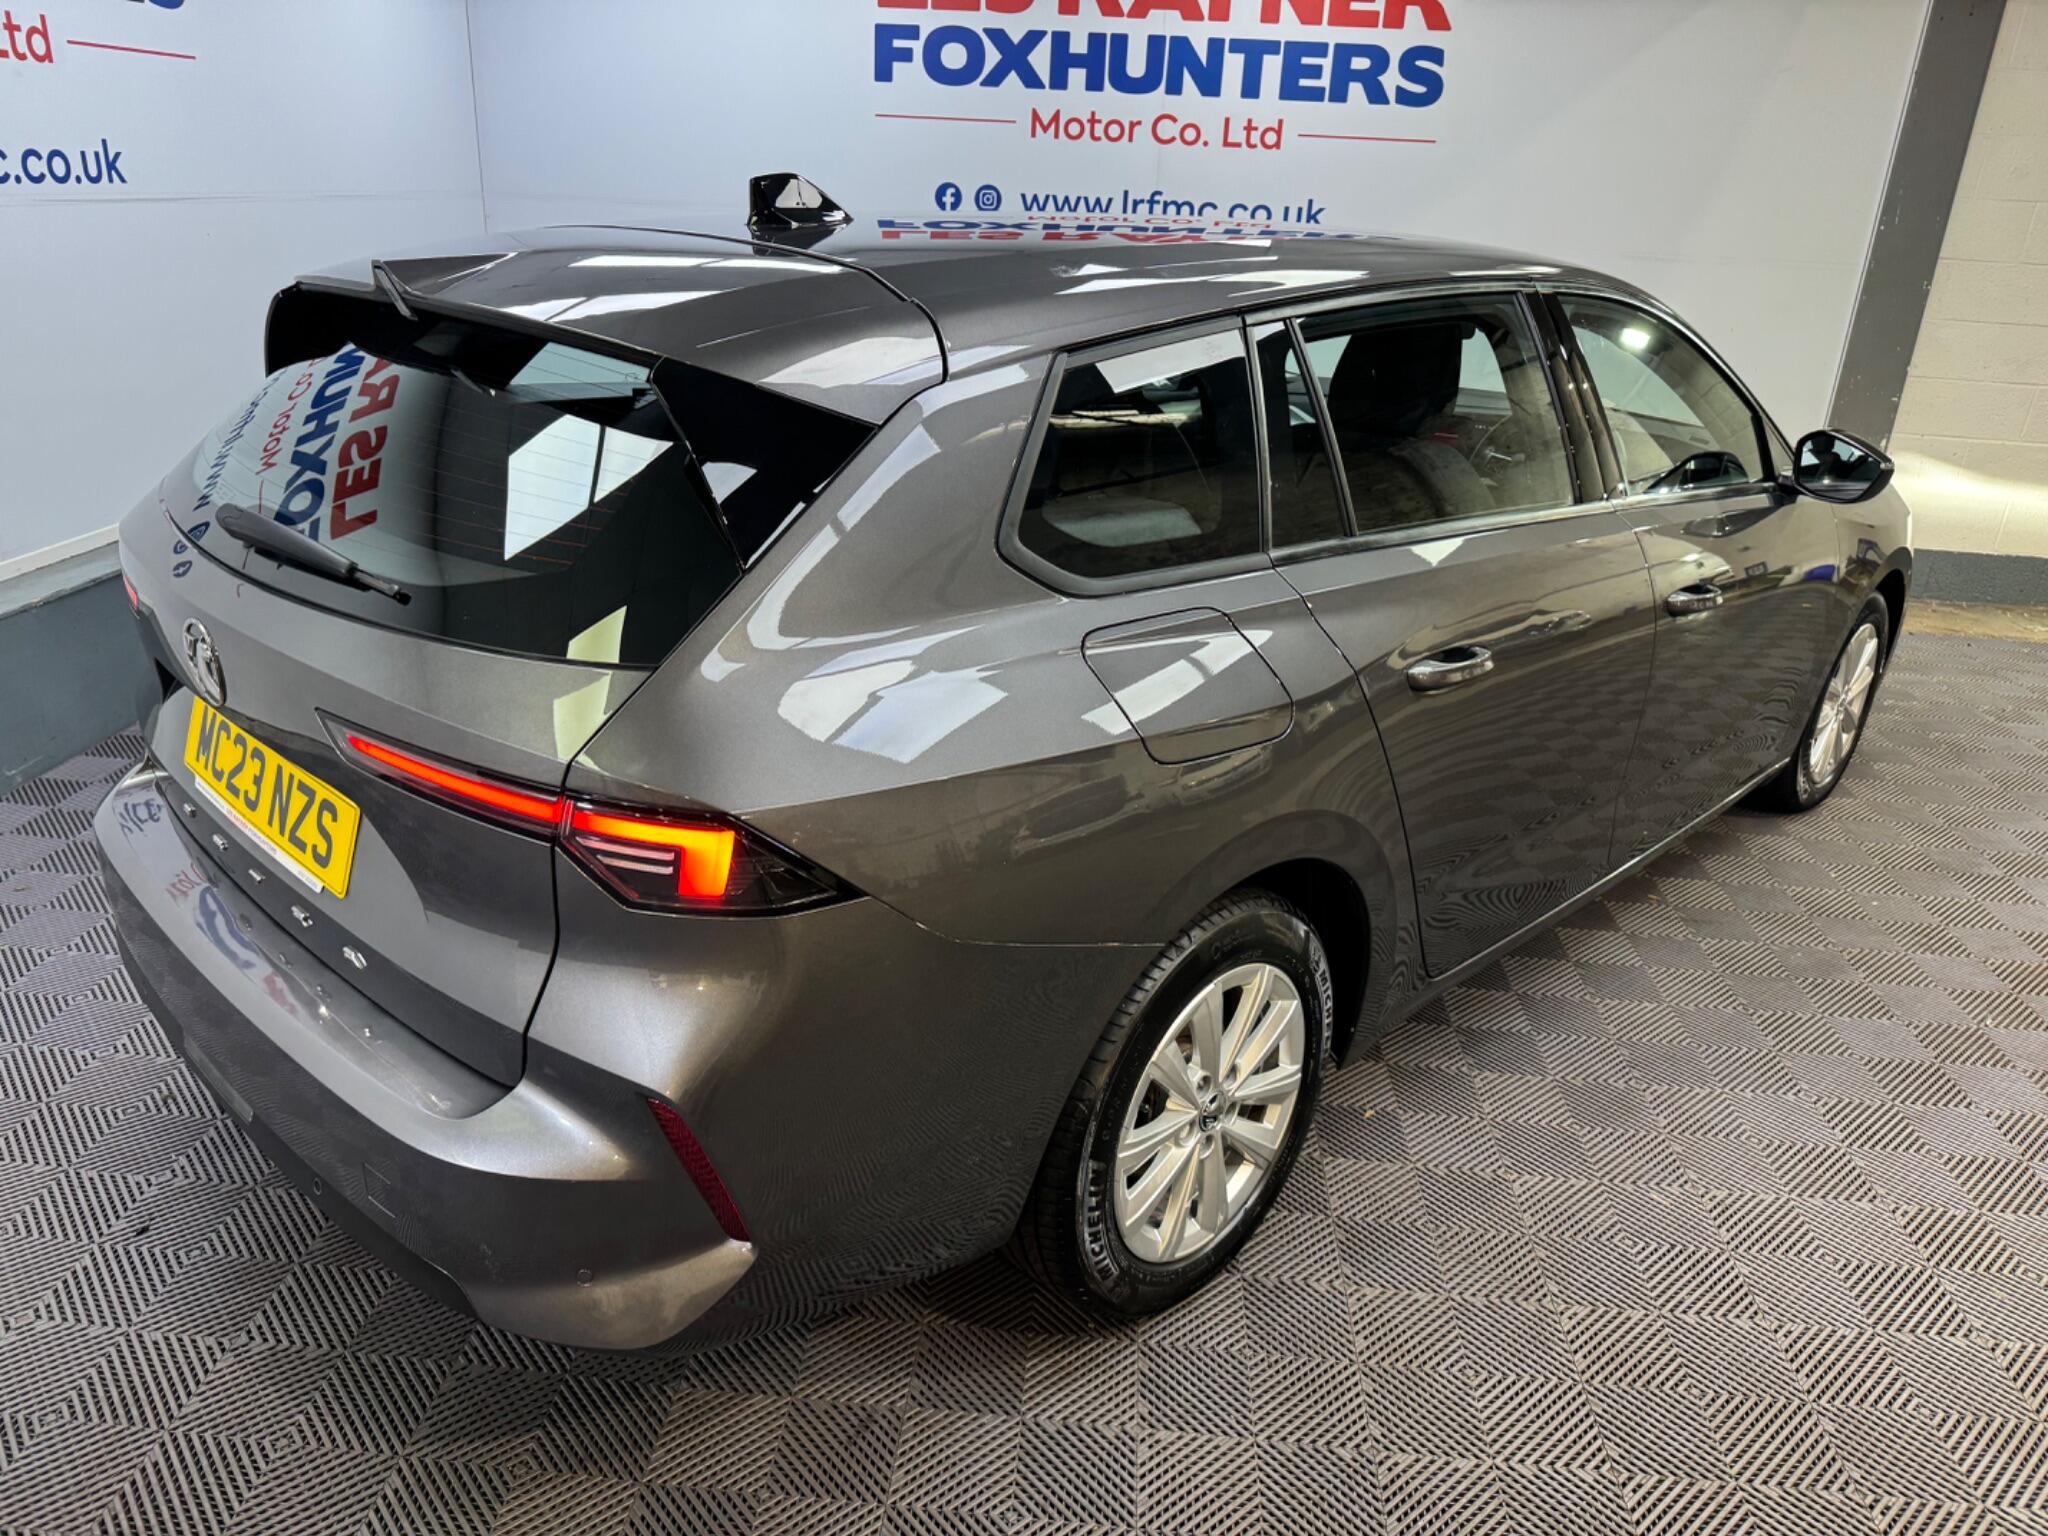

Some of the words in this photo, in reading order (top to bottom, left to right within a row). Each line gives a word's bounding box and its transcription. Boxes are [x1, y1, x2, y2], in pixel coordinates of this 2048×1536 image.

[0, 10, 54, 63] td
[874, 23, 1446, 108] FOXHUNTERS
[1030, 107, 1143, 144] Motor
[1151, 113, 1210, 147] Co.
[1222, 117, 1284, 150] Ltd
[196, 704, 266, 812] MC23
[267, 763, 338, 869] NZS
